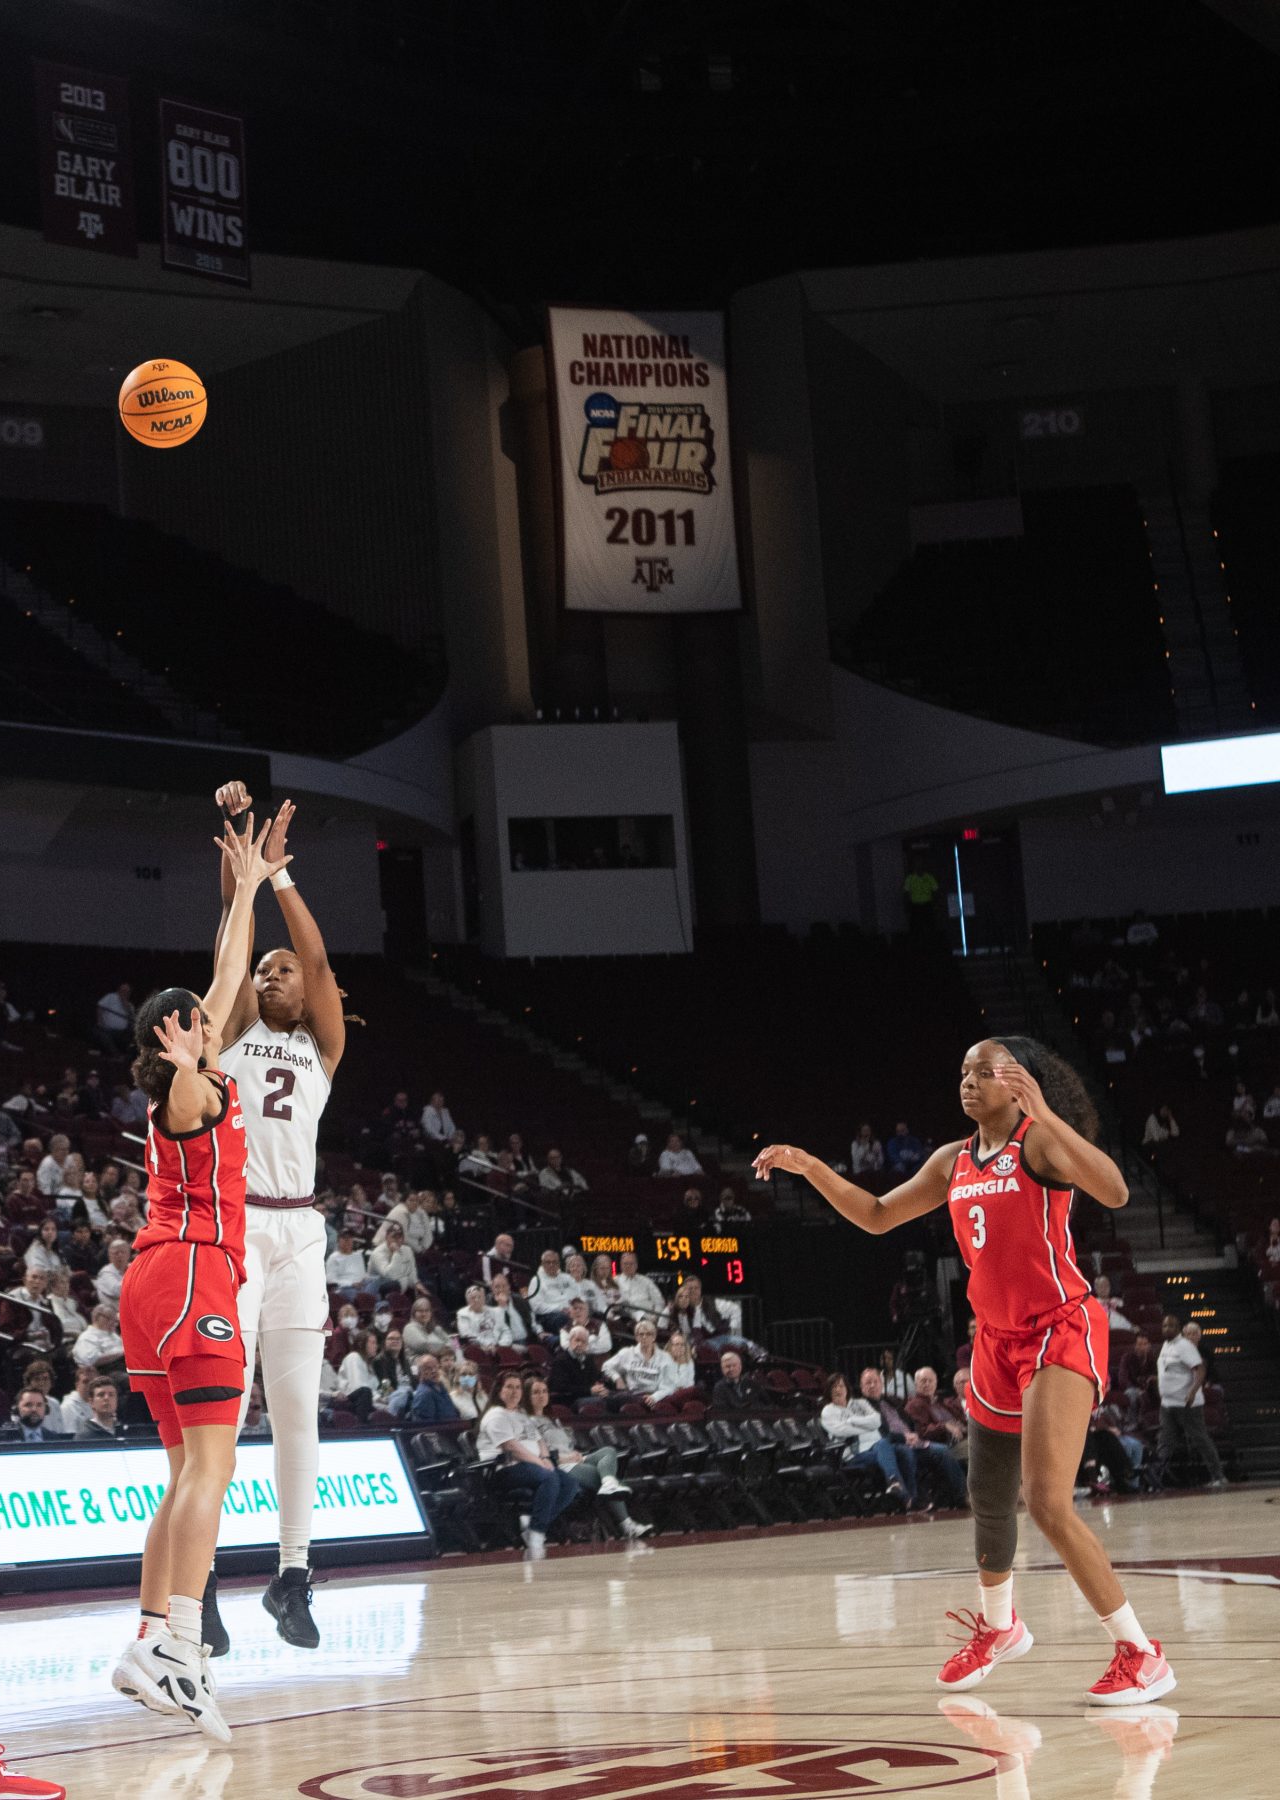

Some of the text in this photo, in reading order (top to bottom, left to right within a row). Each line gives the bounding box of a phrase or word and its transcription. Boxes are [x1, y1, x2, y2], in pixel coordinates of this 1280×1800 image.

[60, 82, 106, 112] 2013
[57, 151, 116, 181] GARY
[168, 139, 240, 200] 800
[54, 173, 122, 208] BLAIR
[171, 202, 243, 248] WINS
[583, 334, 694, 360] NATIONAL
[570, 361, 710, 387] CHAMPIONS
[137, 387, 194, 408] Wilson
[151, 414, 192, 432] NCAA
[590, 409, 616, 418] NCAA
[617, 405, 705, 439] FINAL
[1024, 409, 1081, 438] 210
[597, 470, 707, 488] INDIANAPOLIS
[605, 508, 696, 545] 2011
[244, 1043, 313, 1073] TEXAS A&M
[262, 1067, 296, 1121] 2
[968, 1204, 987, 1249] 3
[656, 1237, 691, 1261] 1:59
[701, 1238, 738, 1253] GEORGIA
[727, 1259, 744, 1284] 13
[196, 1314, 234, 1341] G
[80, 1488, 106, 1524] &
